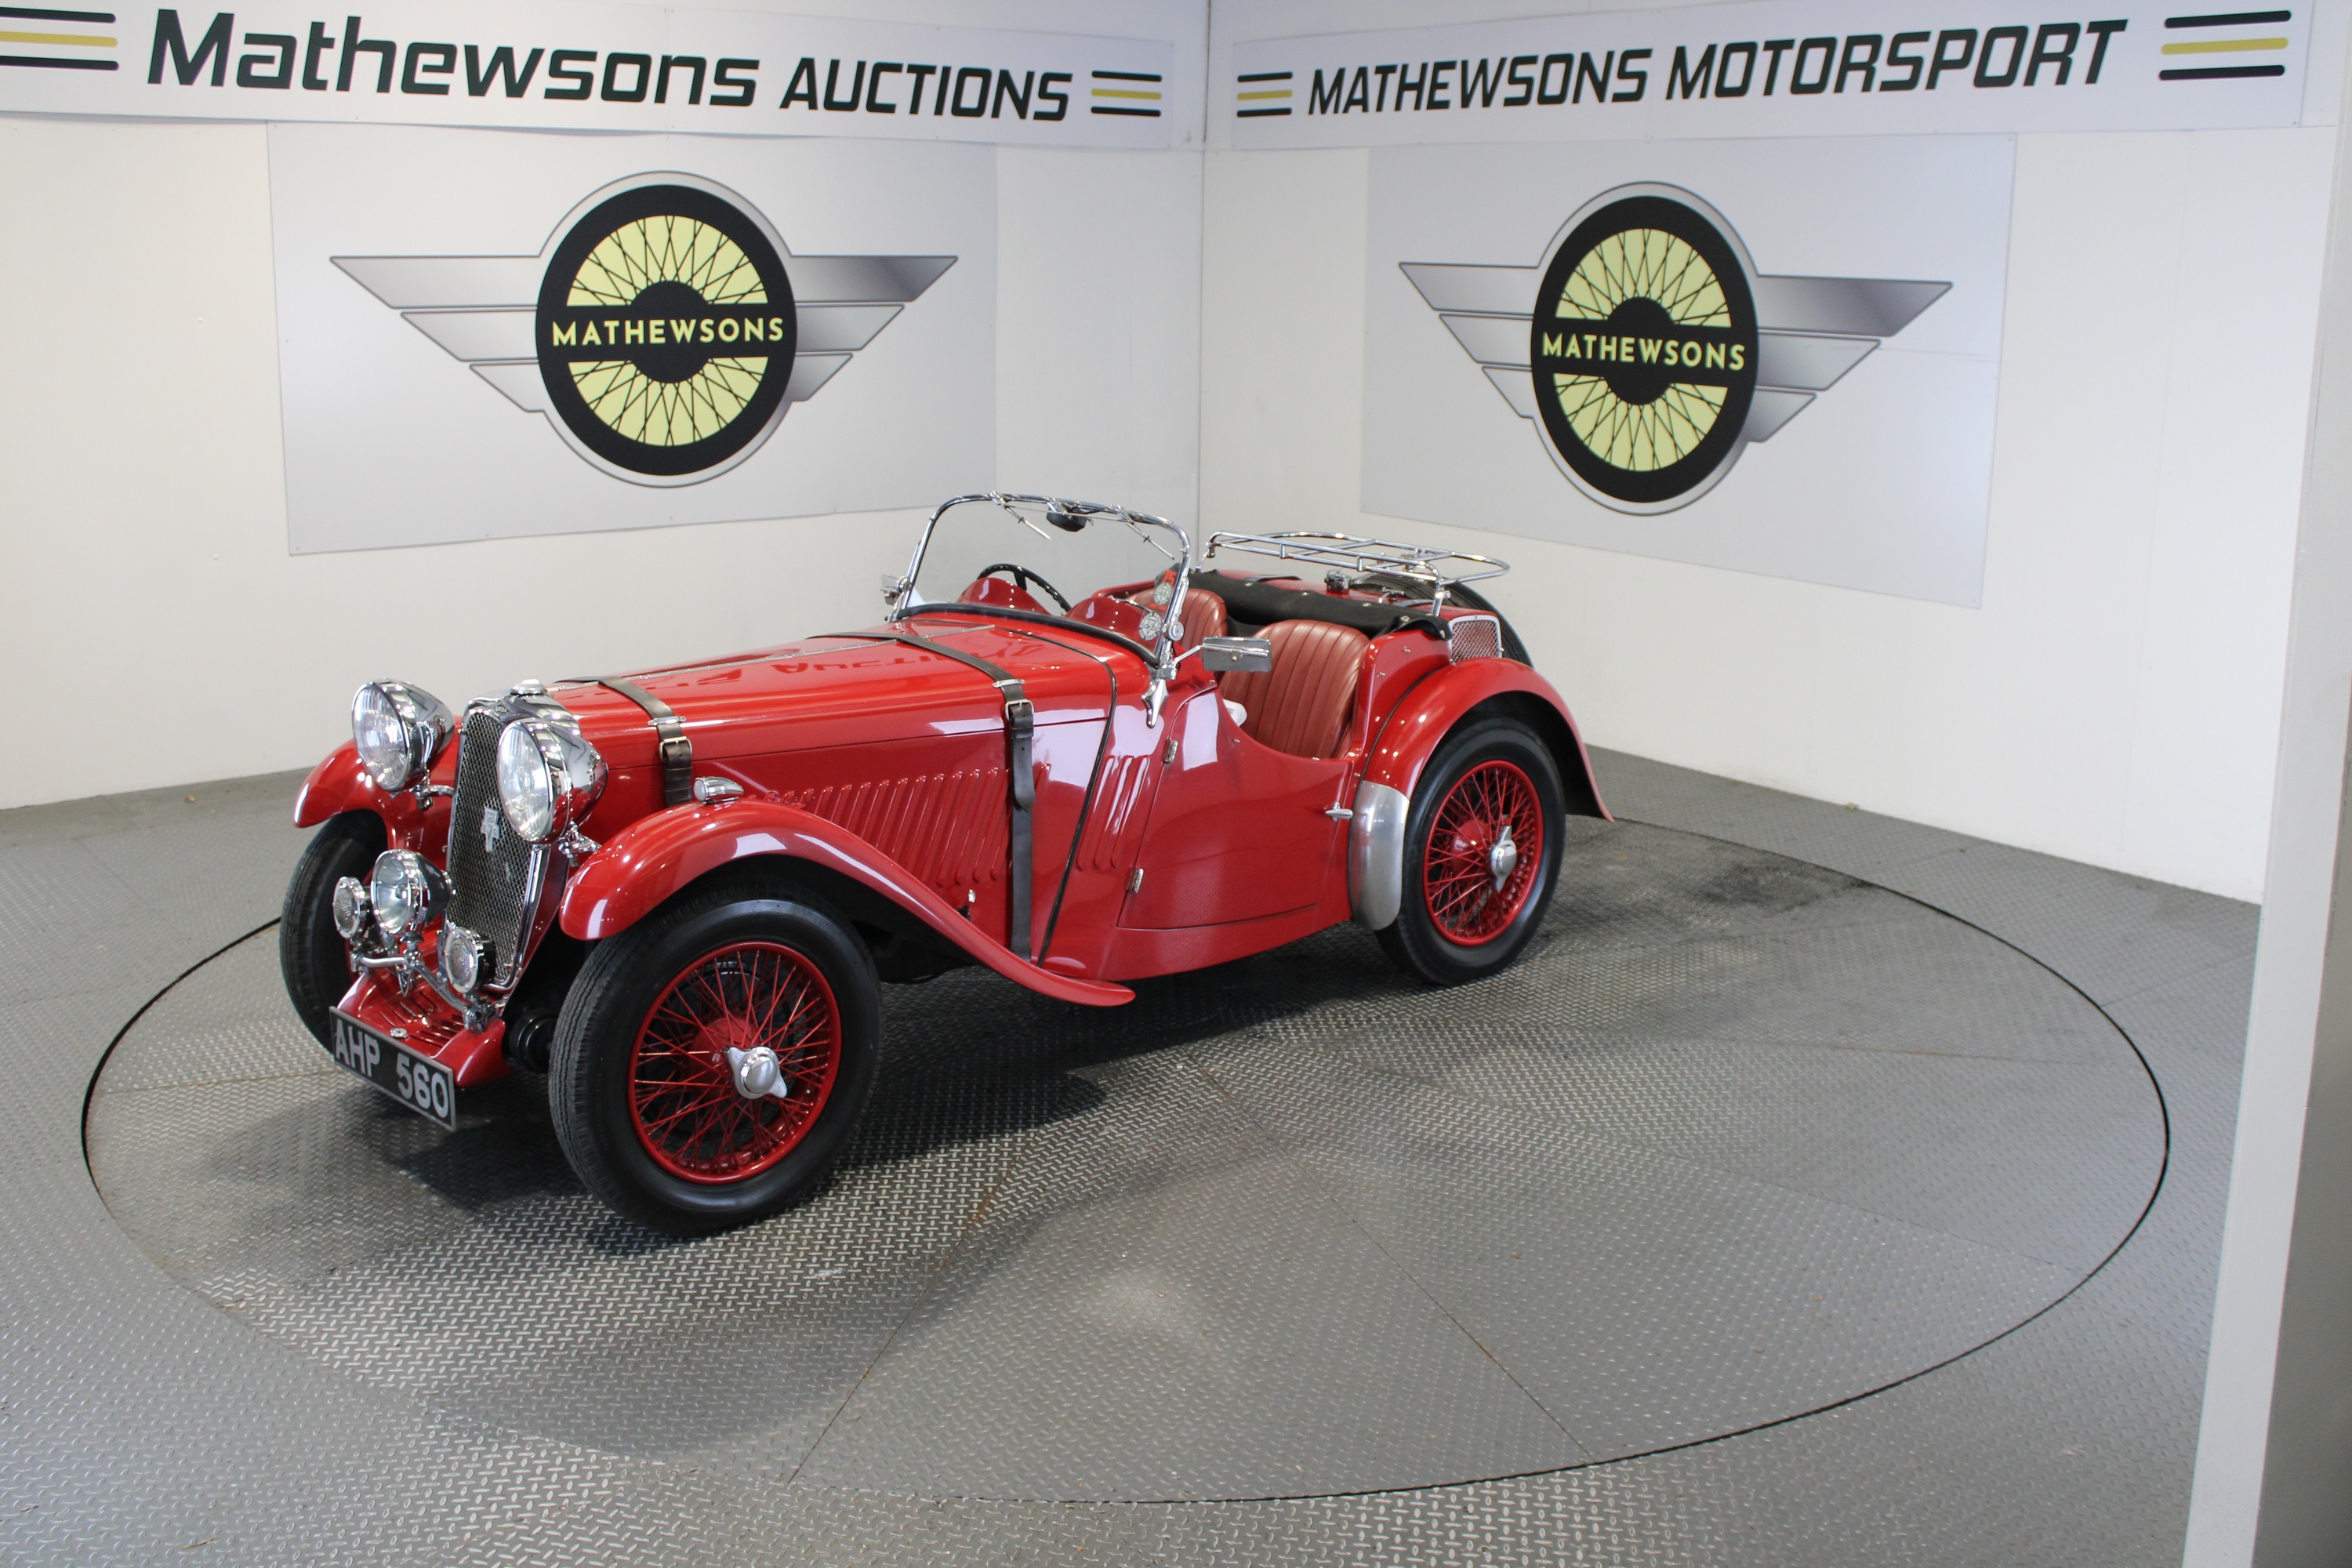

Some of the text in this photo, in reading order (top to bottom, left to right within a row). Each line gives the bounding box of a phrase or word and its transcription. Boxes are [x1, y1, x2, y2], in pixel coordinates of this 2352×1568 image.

[147, 9, 1073, 122] Mathewsons AUCTIONS
[1308, 19, 2129, 116] MATHEWSONS MOTORSPORT
[552, 317, 783, 347] MATHEWSONS
[1543, 332, 1745, 371] MATHEWSONS
[336, 1019, 448, 1118] AHP 560
